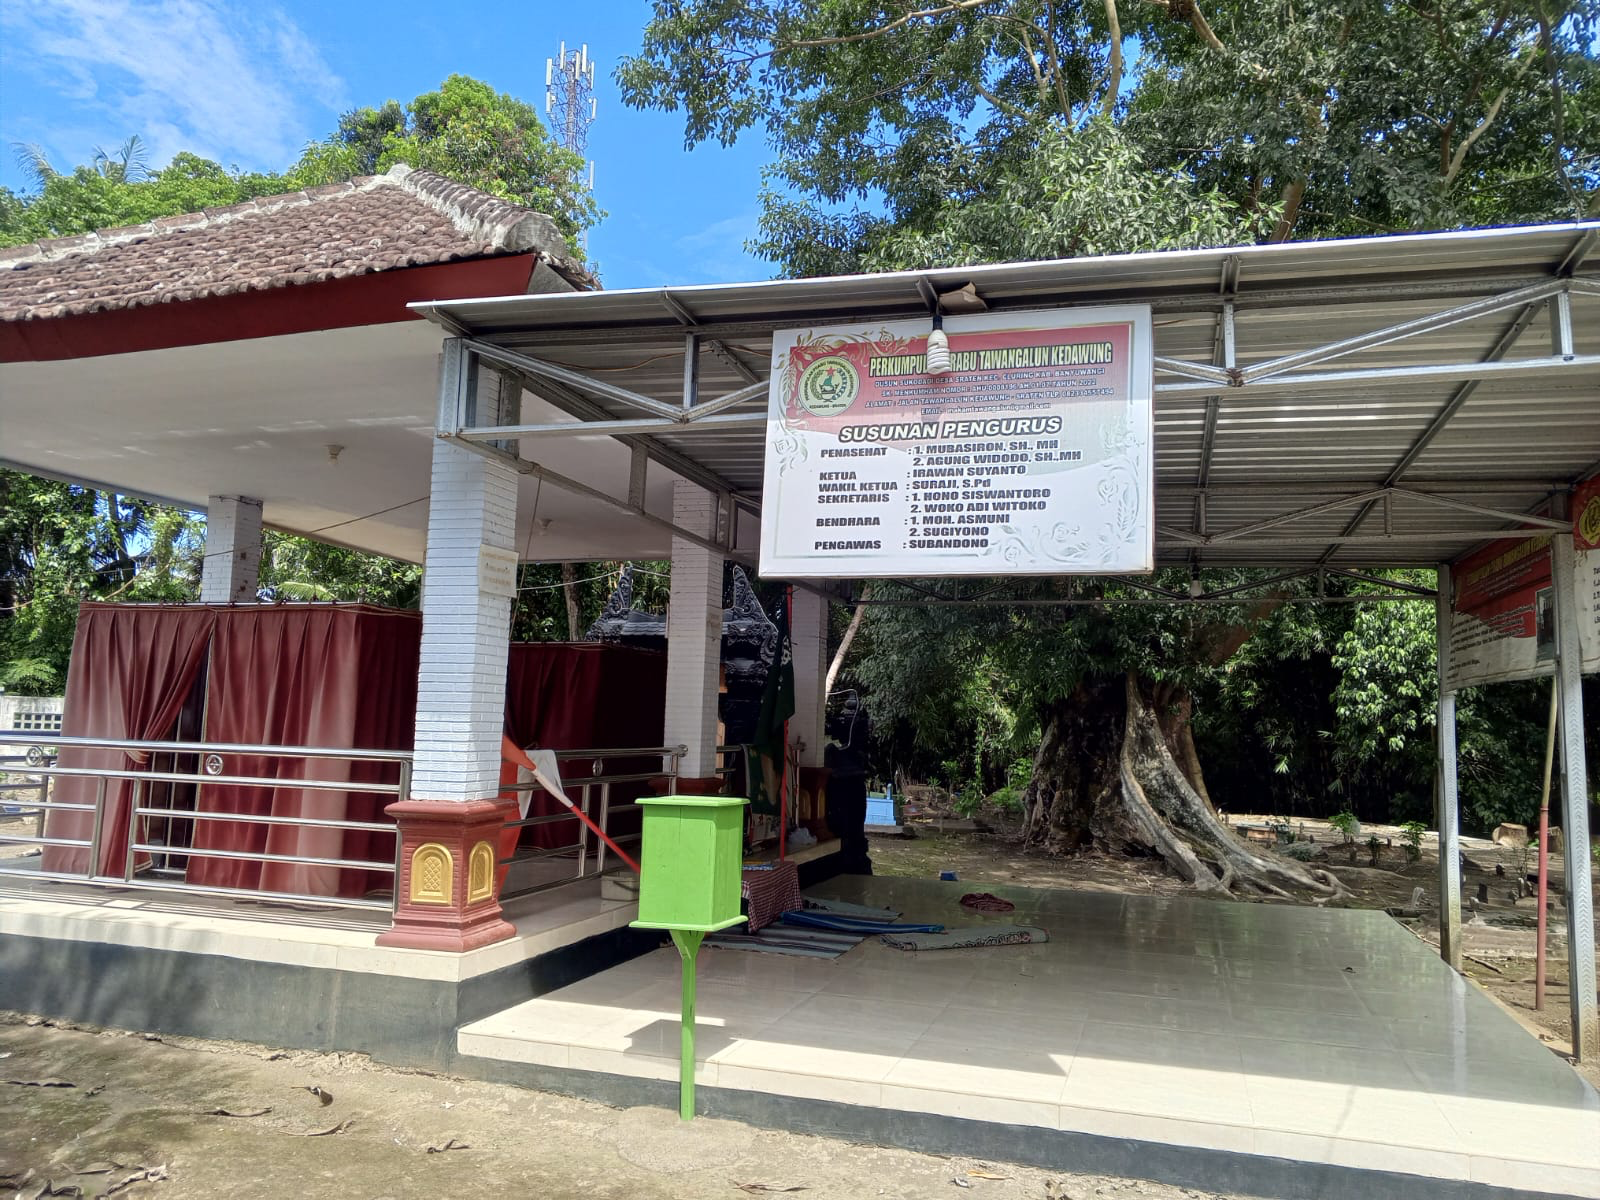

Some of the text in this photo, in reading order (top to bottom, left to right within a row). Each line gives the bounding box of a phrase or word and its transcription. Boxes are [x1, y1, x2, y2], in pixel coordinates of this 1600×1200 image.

[869, 341, 1113, 377] PERKUMPUL RABU TAWANGALUN KEDAWUNG
[1055, 367, 1105, 377] BANYUWANGI
[838, 416, 1063, 443] SUSUNAN PENGURUS
[820, 447, 888, 458] PENASEHAT
[1036, 440, 1059, 449] MH
[926, 455, 971, 466] AGUNG
[819, 471, 857, 481] KETUA
[912, 468, 964, 478] IRAWAN
[967, 465, 1027, 476] SUYANTO
[818, 482, 857, 492] WAKIL
[859, 481, 898, 491] KETUA
[962, 479, 991, 488] S.Pd
[817, 493, 890, 504] SEKRETARIS
[961, 488, 1051, 500] SISWANTORO
[924, 503, 964, 513] WOKO
[966, 502, 989, 511] ADI
[992, 500, 1047, 511] WITOKO
[816, 517, 881, 527] BENDHARA
[922, 515, 955, 525] MOH.
[957, 514, 1010, 524] ASMUNI
[923, 526, 989, 537] SUGIYONO
[814, 540, 882, 550] PENGAWAS
[909, 538, 989, 549] SUBANDONO
